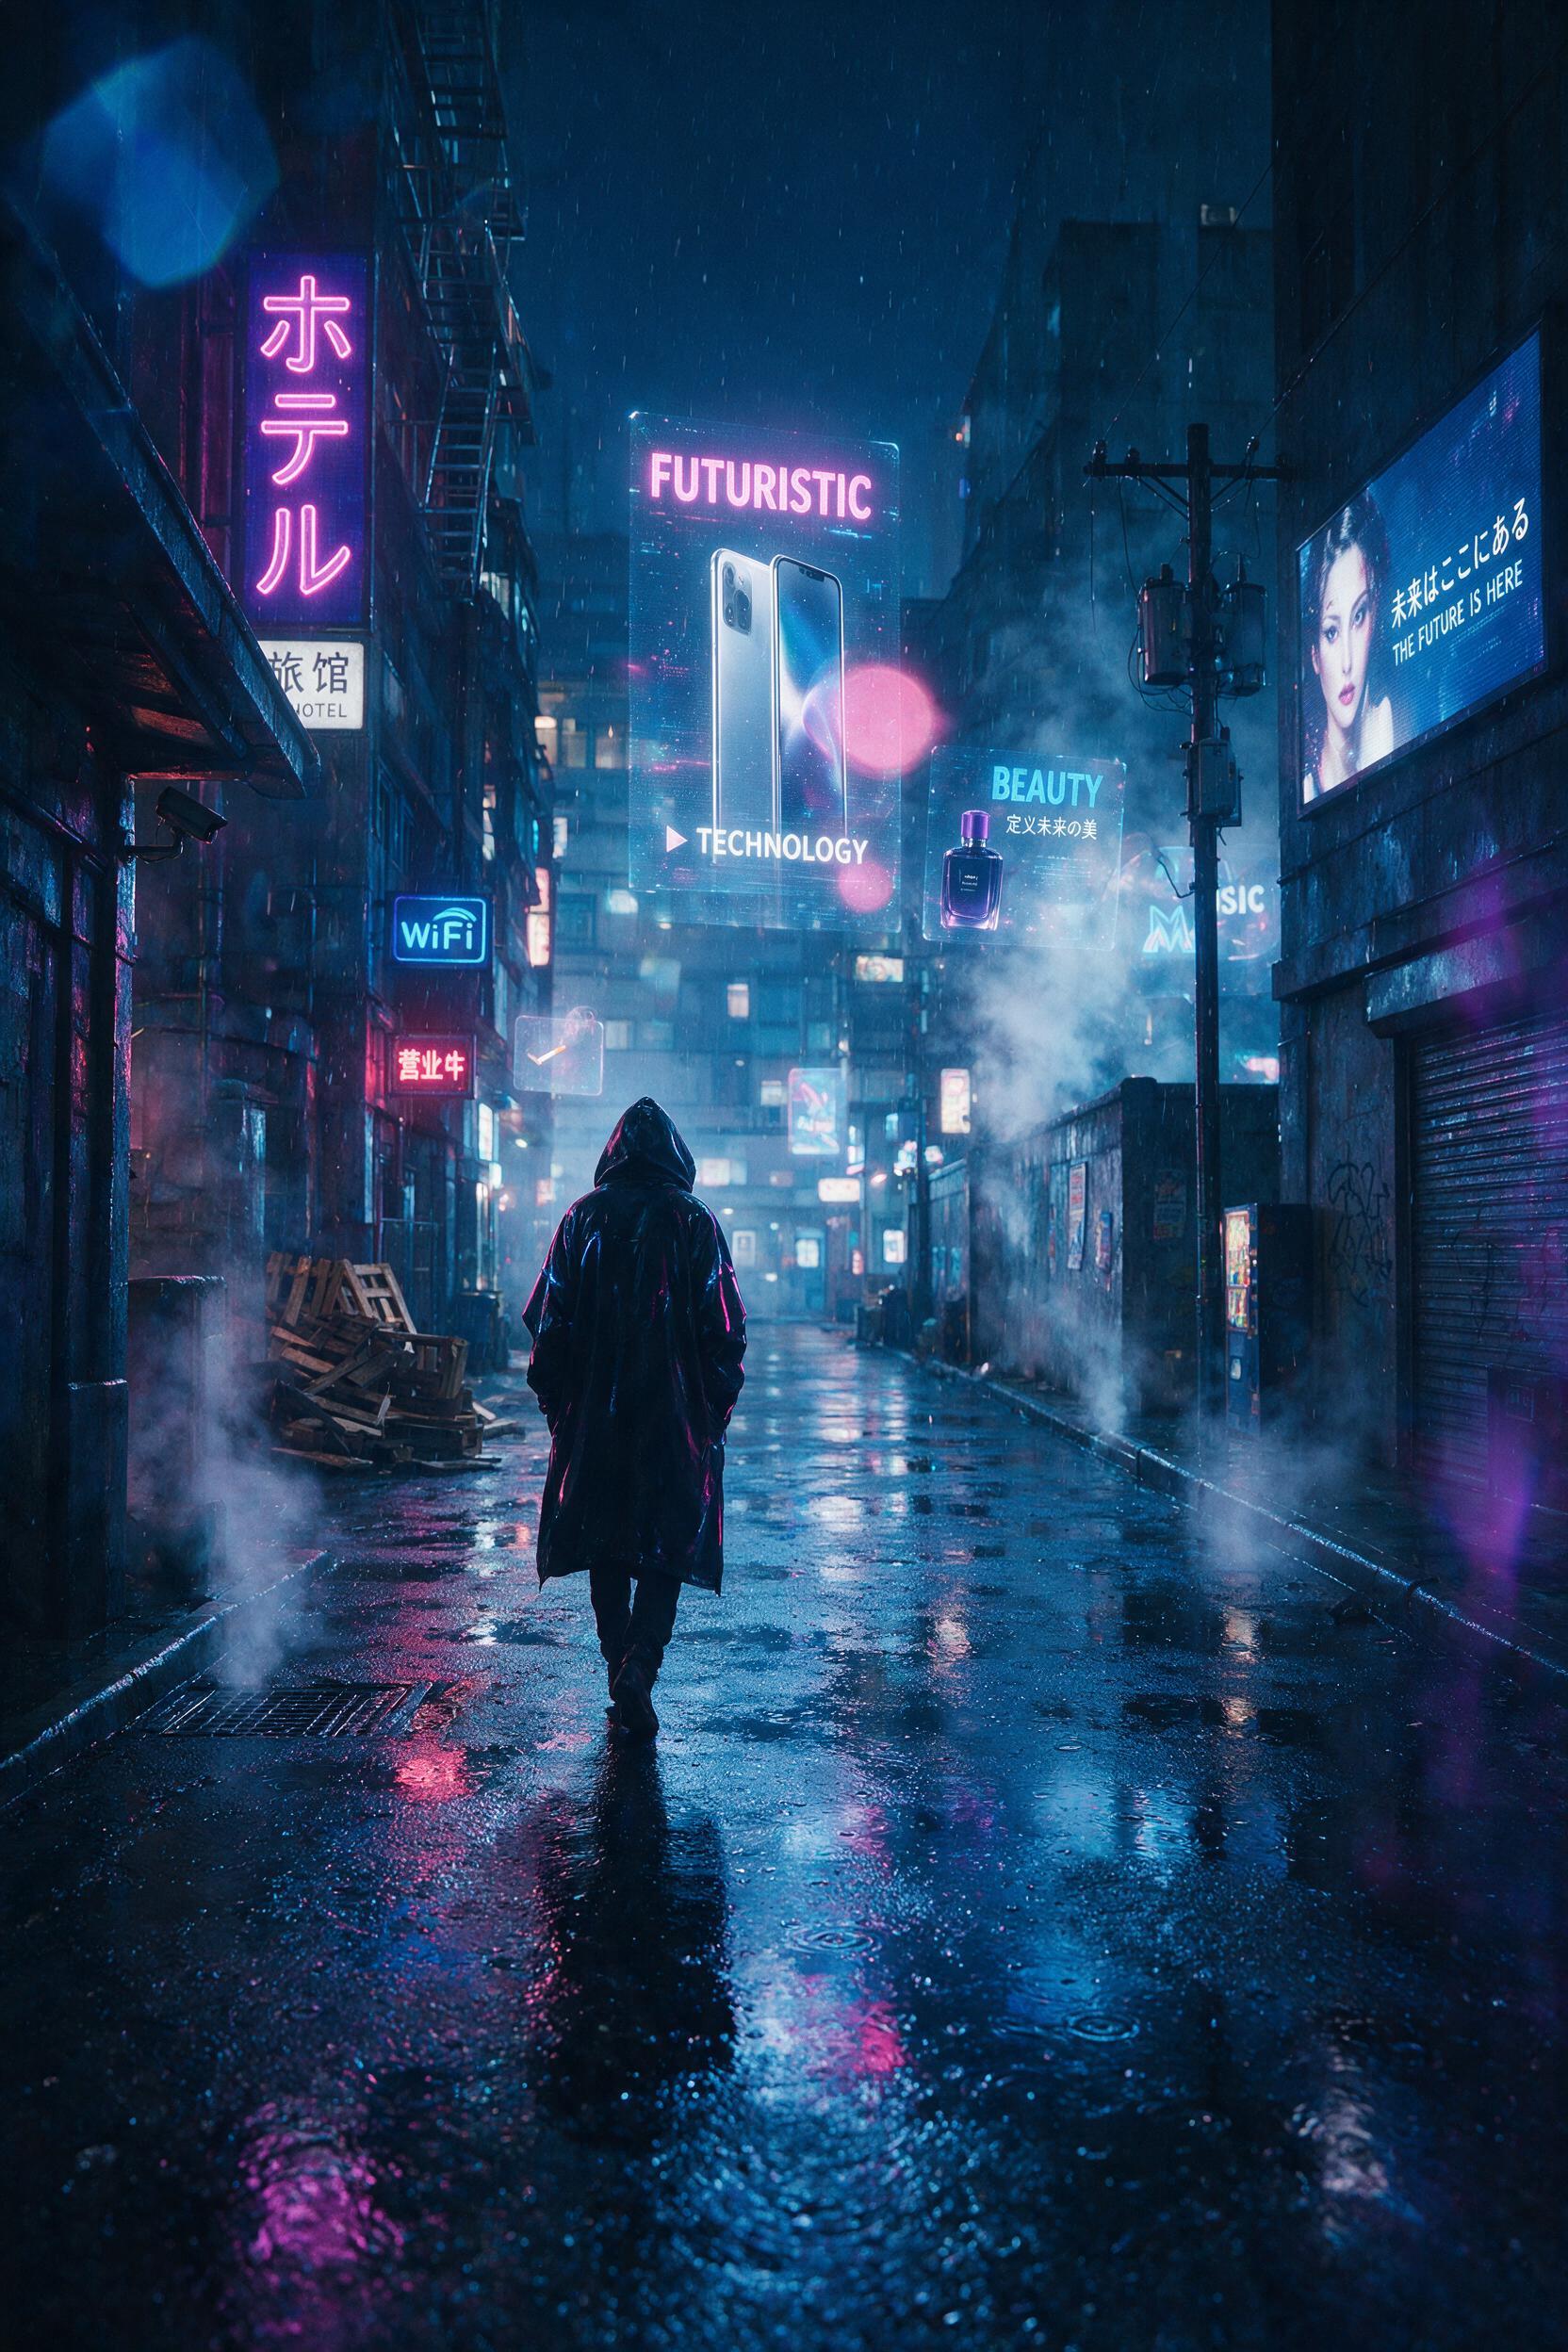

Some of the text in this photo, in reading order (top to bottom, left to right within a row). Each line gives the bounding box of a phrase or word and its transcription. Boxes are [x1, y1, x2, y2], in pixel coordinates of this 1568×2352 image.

[256, 275, 351, 596] ホテル
[650, 451, 873, 520] FUTURISTIC
[1391, 497, 1529, 629] 未来はここにある
[1393, 633, 1415, 666] THE
[1418, 598, 1465, 651] FUTURE
[1470, 587, 1482, 616] IS
[1486, 559, 1524, 606] HERE
[268, 651, 349, 694] 旅馆
[991, 765, 1103, 808] BEAUTY
[695, 827, 869, 864] TECHNOLOGY
[1005, 814, 1097, 841] 定义未来の美
[400, 921, 473, 950] WiFi
